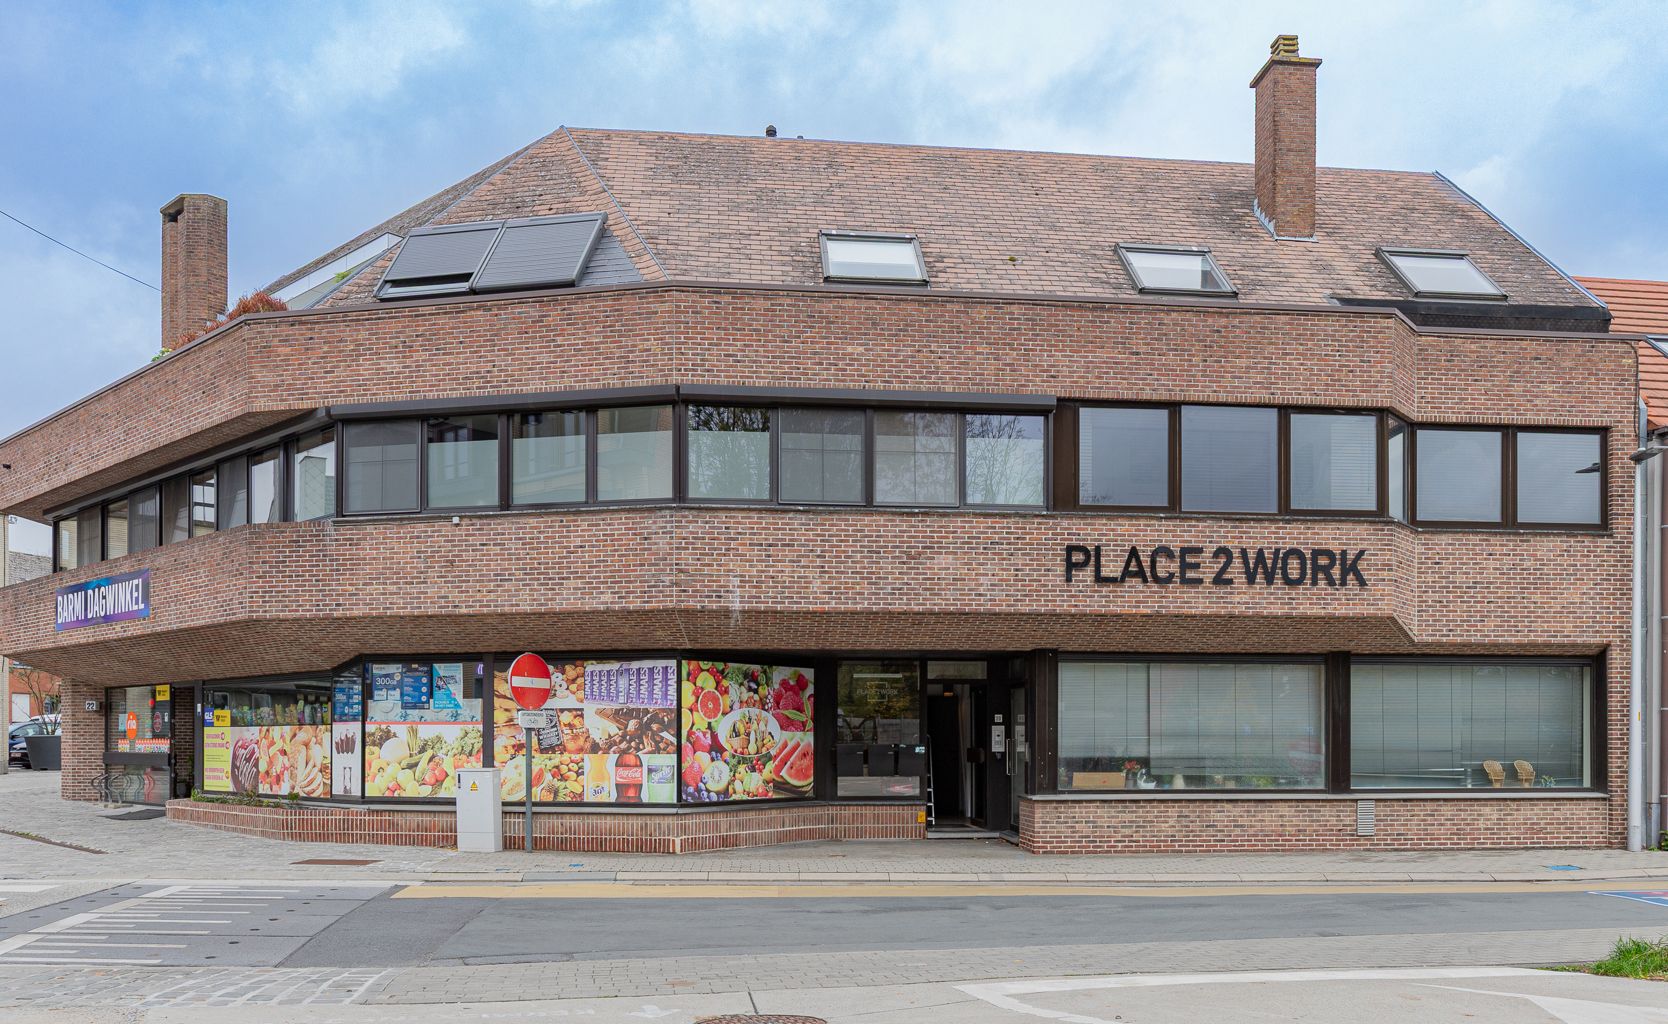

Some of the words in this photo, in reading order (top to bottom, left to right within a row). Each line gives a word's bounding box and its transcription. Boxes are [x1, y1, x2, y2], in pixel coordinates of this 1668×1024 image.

[1064, 544, 1369, 587] PLACE2WORK
[57, 591, 85, 624] BARMI
[87, 578, 145, 619] DAGWINKEL
[86, 702, 95, 710] 22
